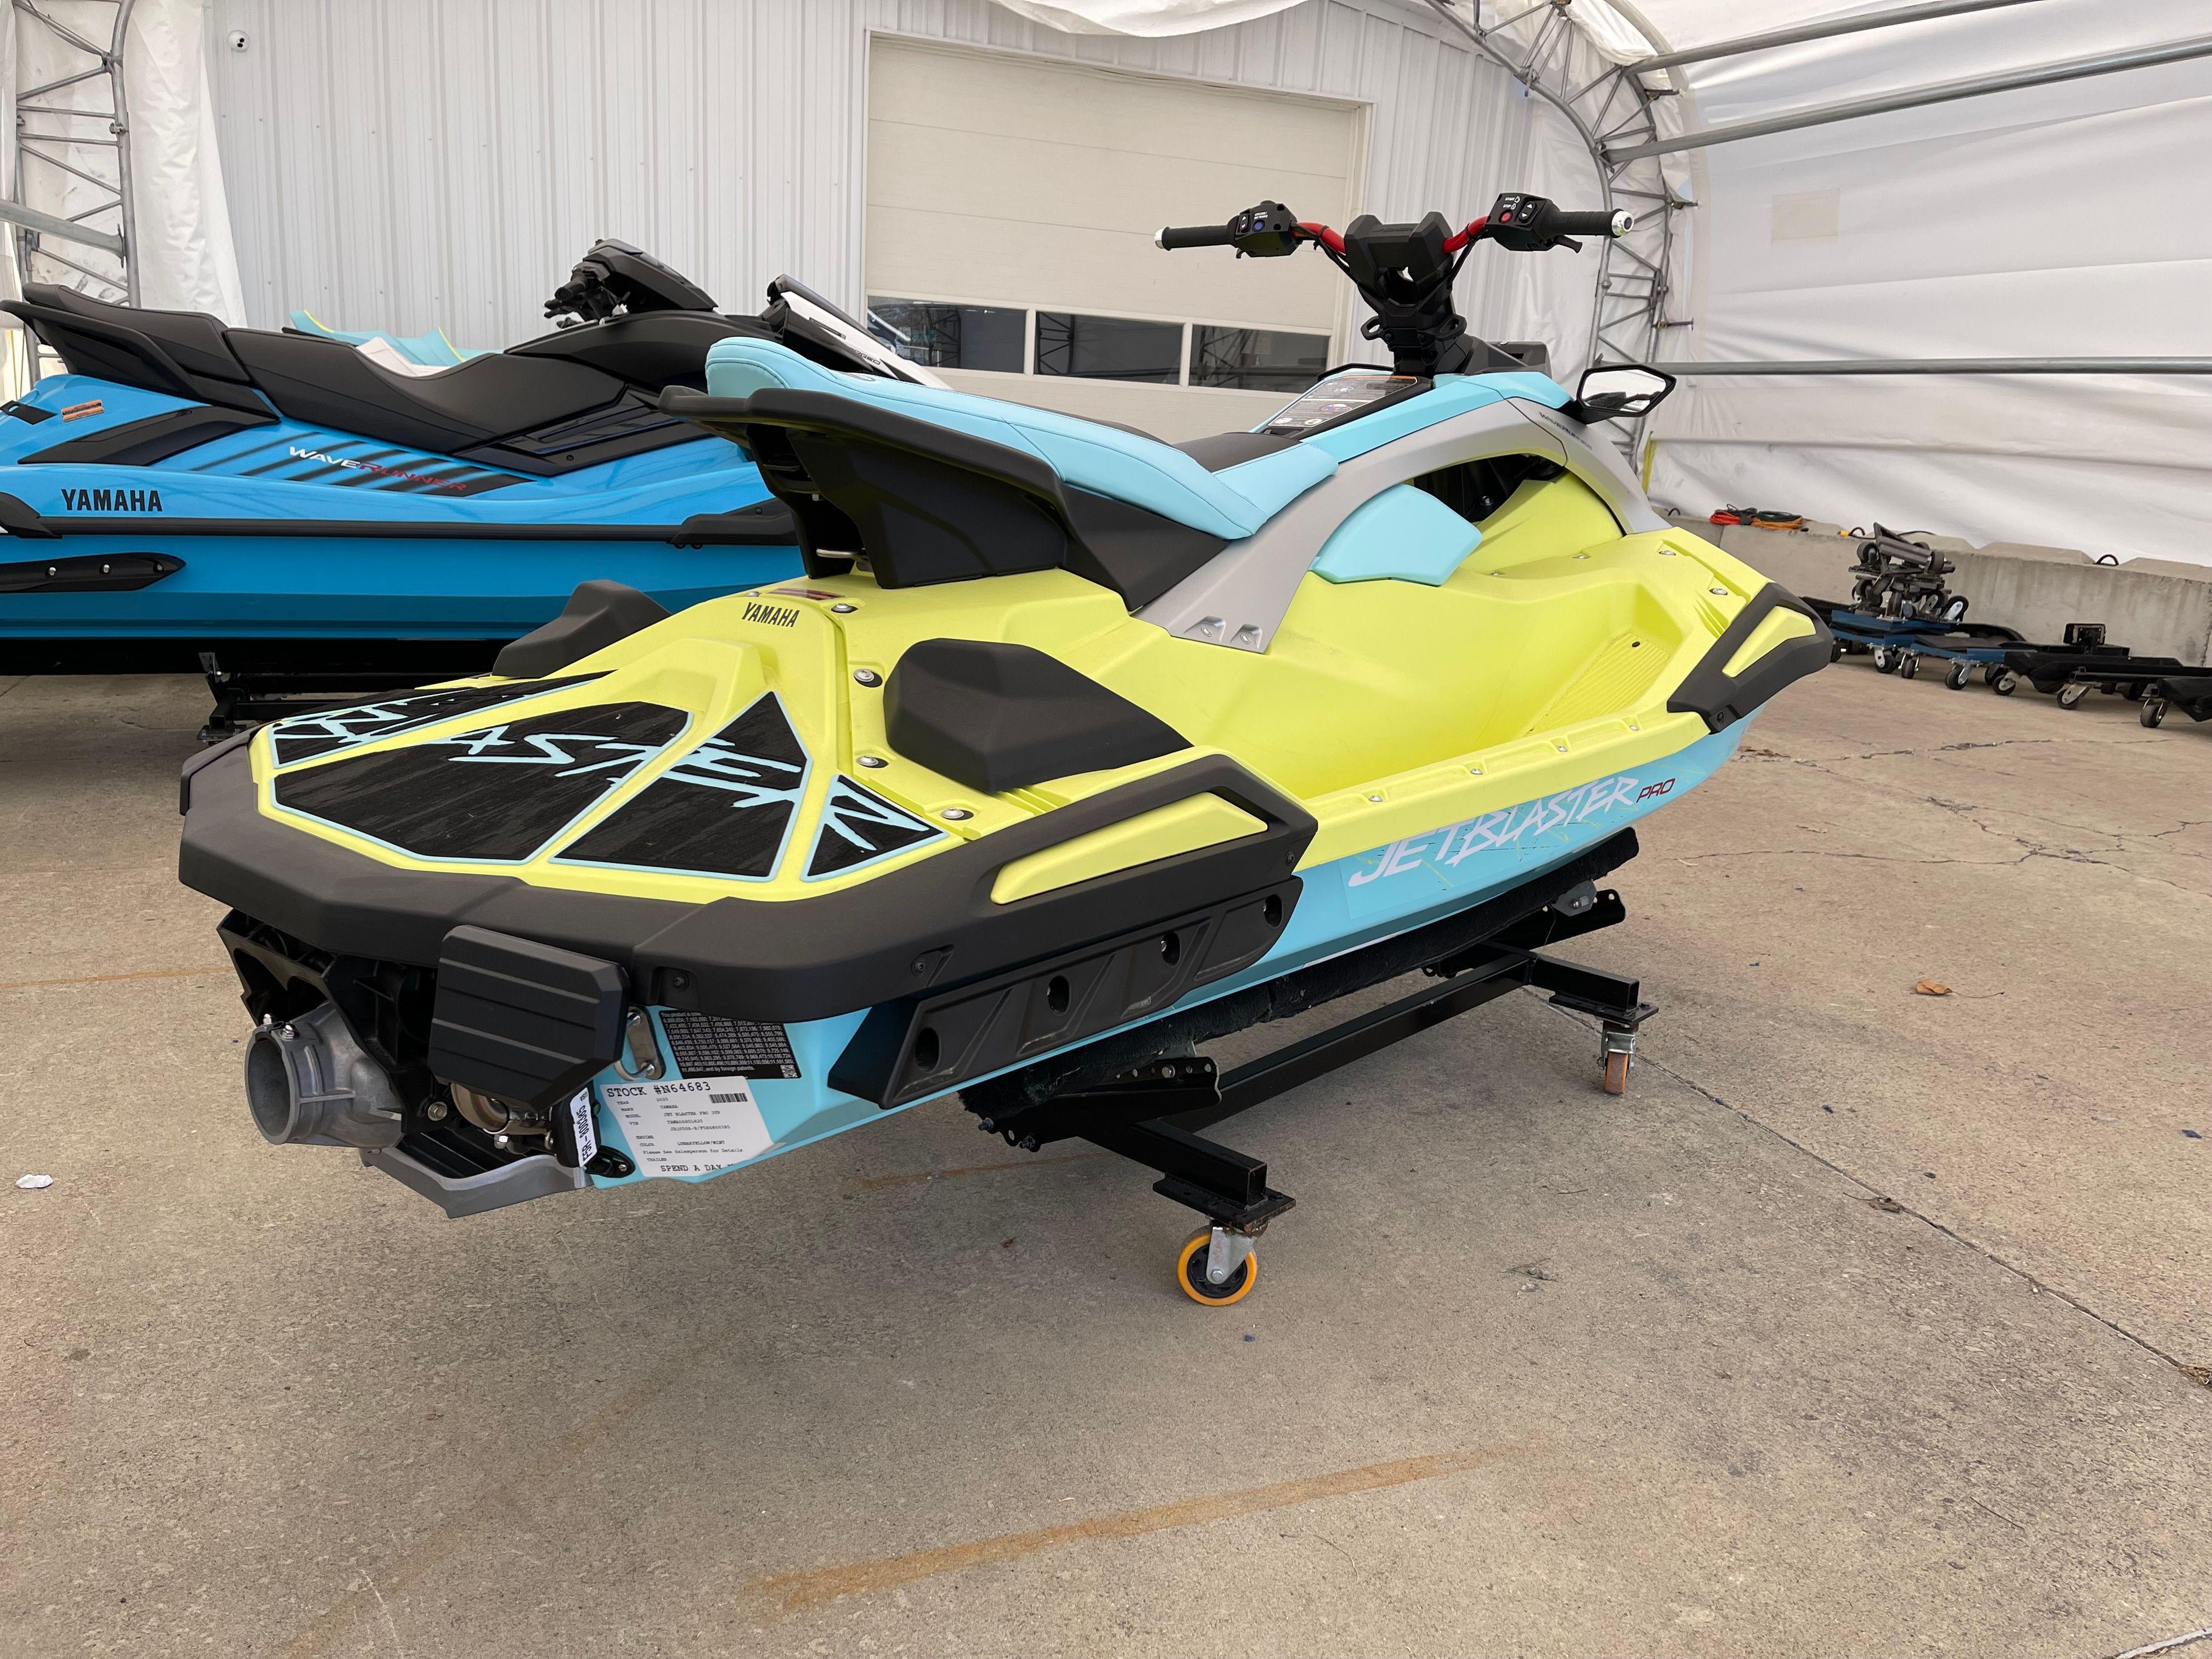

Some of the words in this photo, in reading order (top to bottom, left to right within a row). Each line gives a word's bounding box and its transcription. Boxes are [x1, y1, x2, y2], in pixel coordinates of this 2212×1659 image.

[60, 488, 163, 512] YAMAHA
[741, 602, 800, 628] YAMAHA
[1635, 778, 1676, 803] PRO
[607, 1087, 647, 1097] STOCK
[653, 1081, 711, 1094] #N64683
